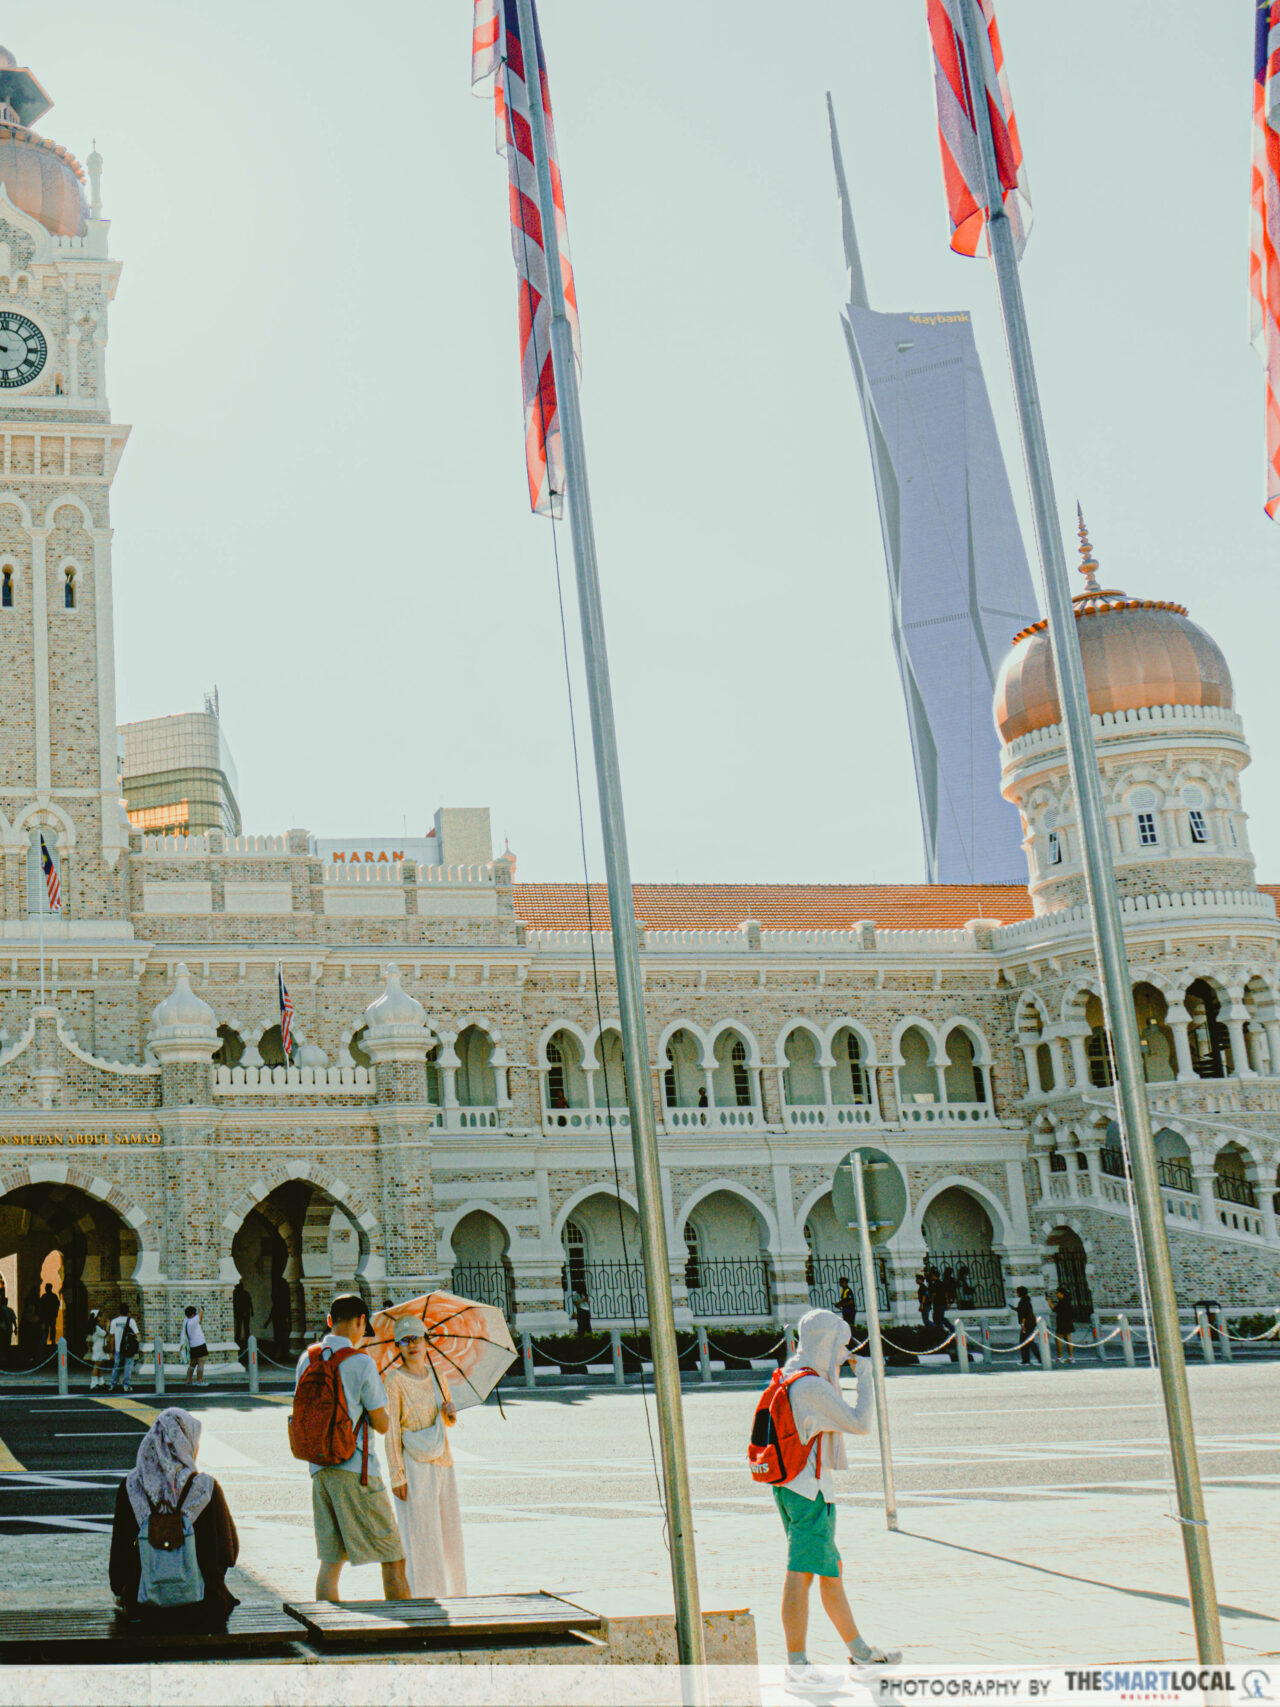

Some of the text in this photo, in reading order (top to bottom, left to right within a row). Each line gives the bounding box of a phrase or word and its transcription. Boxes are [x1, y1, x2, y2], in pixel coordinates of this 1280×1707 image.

[909, 313, 968, 326] Maybank
[333, 851, 405, 863] MARAN
[12, 1134, 64, 1146] SULTAN
[67, 1133, 110, 1145] ABDUL
[114, 1133, 162, 1145] SAMAD
